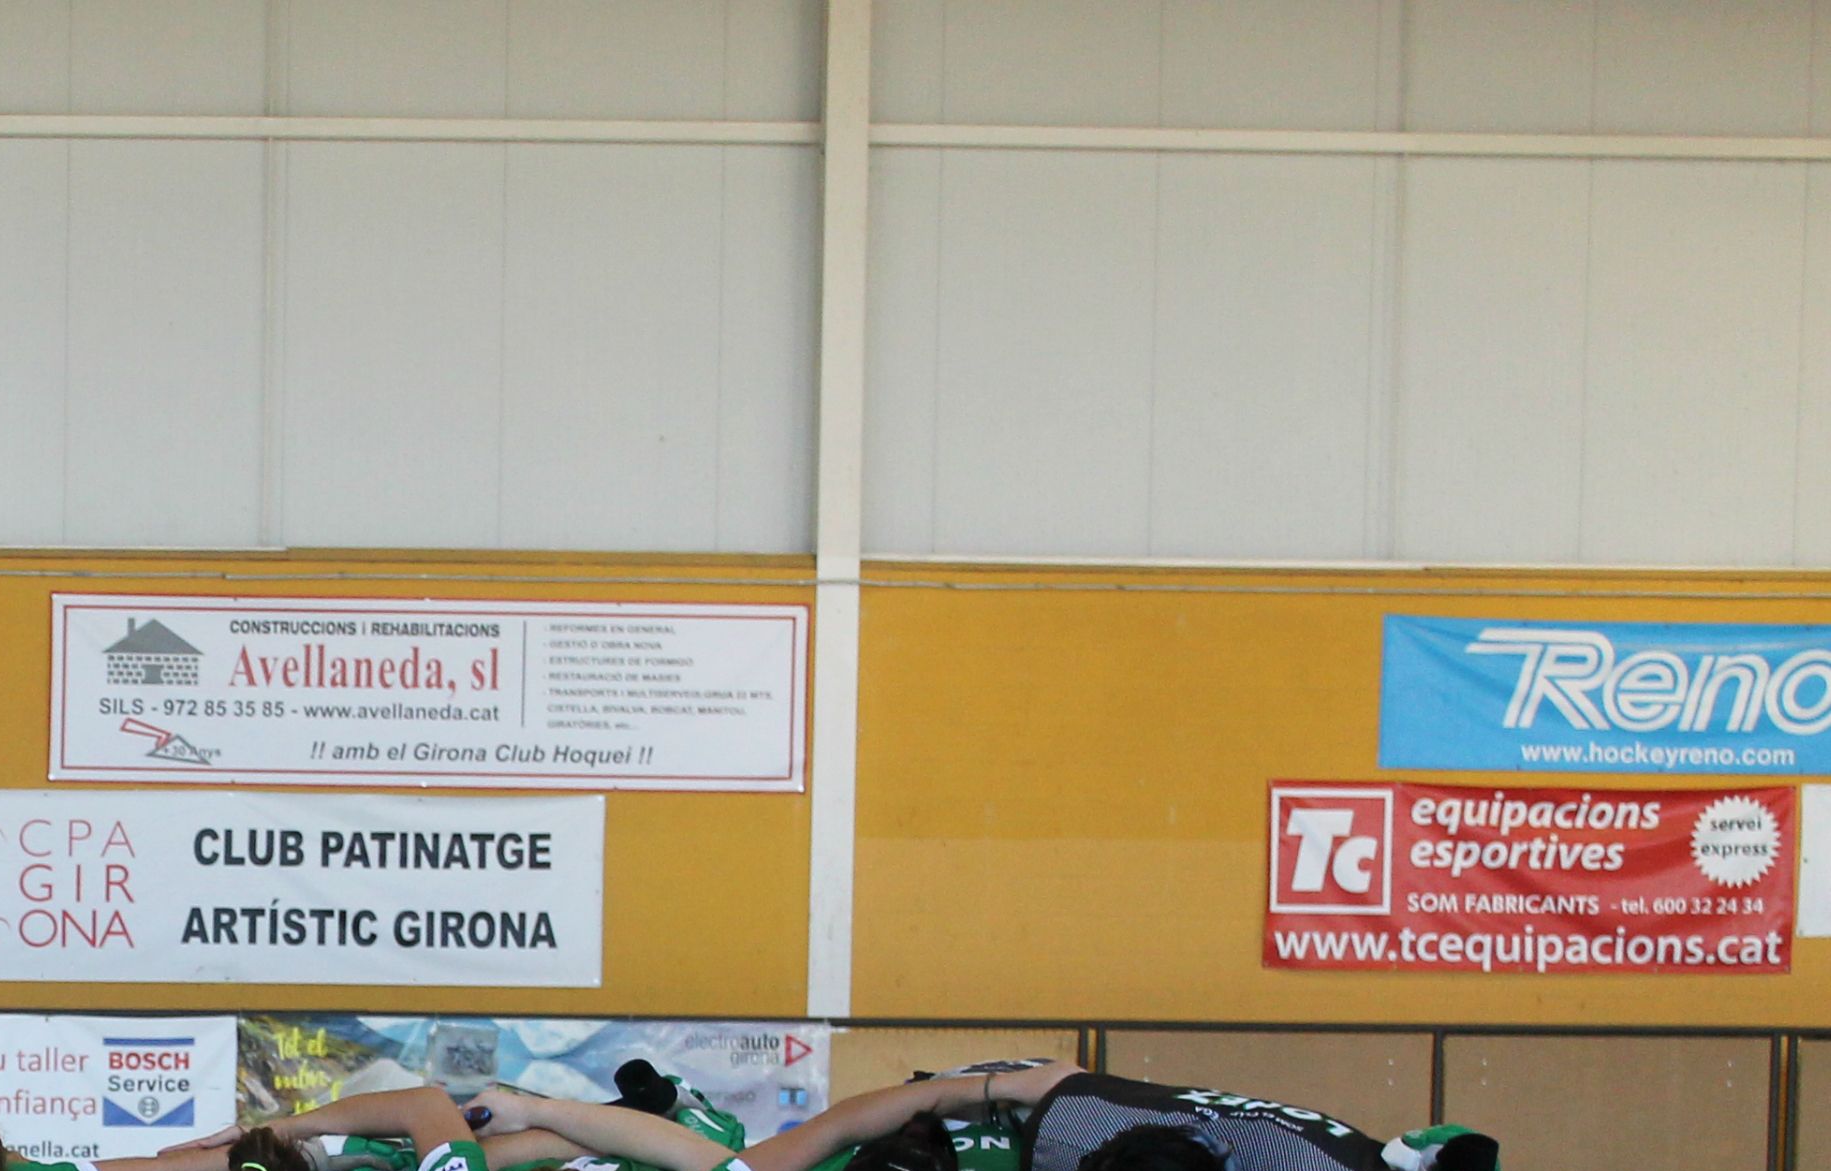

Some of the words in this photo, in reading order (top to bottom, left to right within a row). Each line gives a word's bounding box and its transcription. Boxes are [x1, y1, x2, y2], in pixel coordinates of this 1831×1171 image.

[230, 620, 357, 636] CONSTRUCCIONS
[371, 622, 500, 638] REHABILITACIONS
[228, 643, 456, 696] Avellaneda,
[470, 647, 499, 691] sl
[1465, 627, 1831, 736] Reno
[98, 698, 144, 716] SILS
[163, 699, 197, 717] 972
[203, 700, 228, 718] 85
[233, 700, 258, 718] 35
[262, 701, 286, 718] 85
[303, 703, 499, 722] www.avellaneda.cat
[332, 743, 379, 762] amb
[387, 743, 406, 761] el
[413, 744, 487, 763] Girona
[494, 744, 546, 764] Club
[552, 745, 633, 767] Hoquei
[1520, 740, 1794, 768] www.hockeyreno.com
[1410, 792, 1661, 836] equipacions
[1709, 816, 1763, 832] servei
[192, 827, 304, 867] CLUB
[319, 830, 553, 870] PATINATGE
[1286, 808, 1378, 893] Tc
[1410, 836, 1625, 877] esportives
[1698, 842, 1769, 860] express
[1407, 892, 1458, 913] SOM
[1464, 892, 1600, 915] FABRICANTS
[1621, 896, 1649, 915] tel.
[1716, 897, 1738, 915] 24
[181, 899, 379, 946] ARTÍSTIC
[392, 907, 558, 949] GIRONA
[1273, 925, 1783, 973] www.tcequipacions.cat
[18, 1047, 90, 1073] taller
[108, 1051, 190, 1071] BOSCH
[108, 1075, 191, 1093] Service
